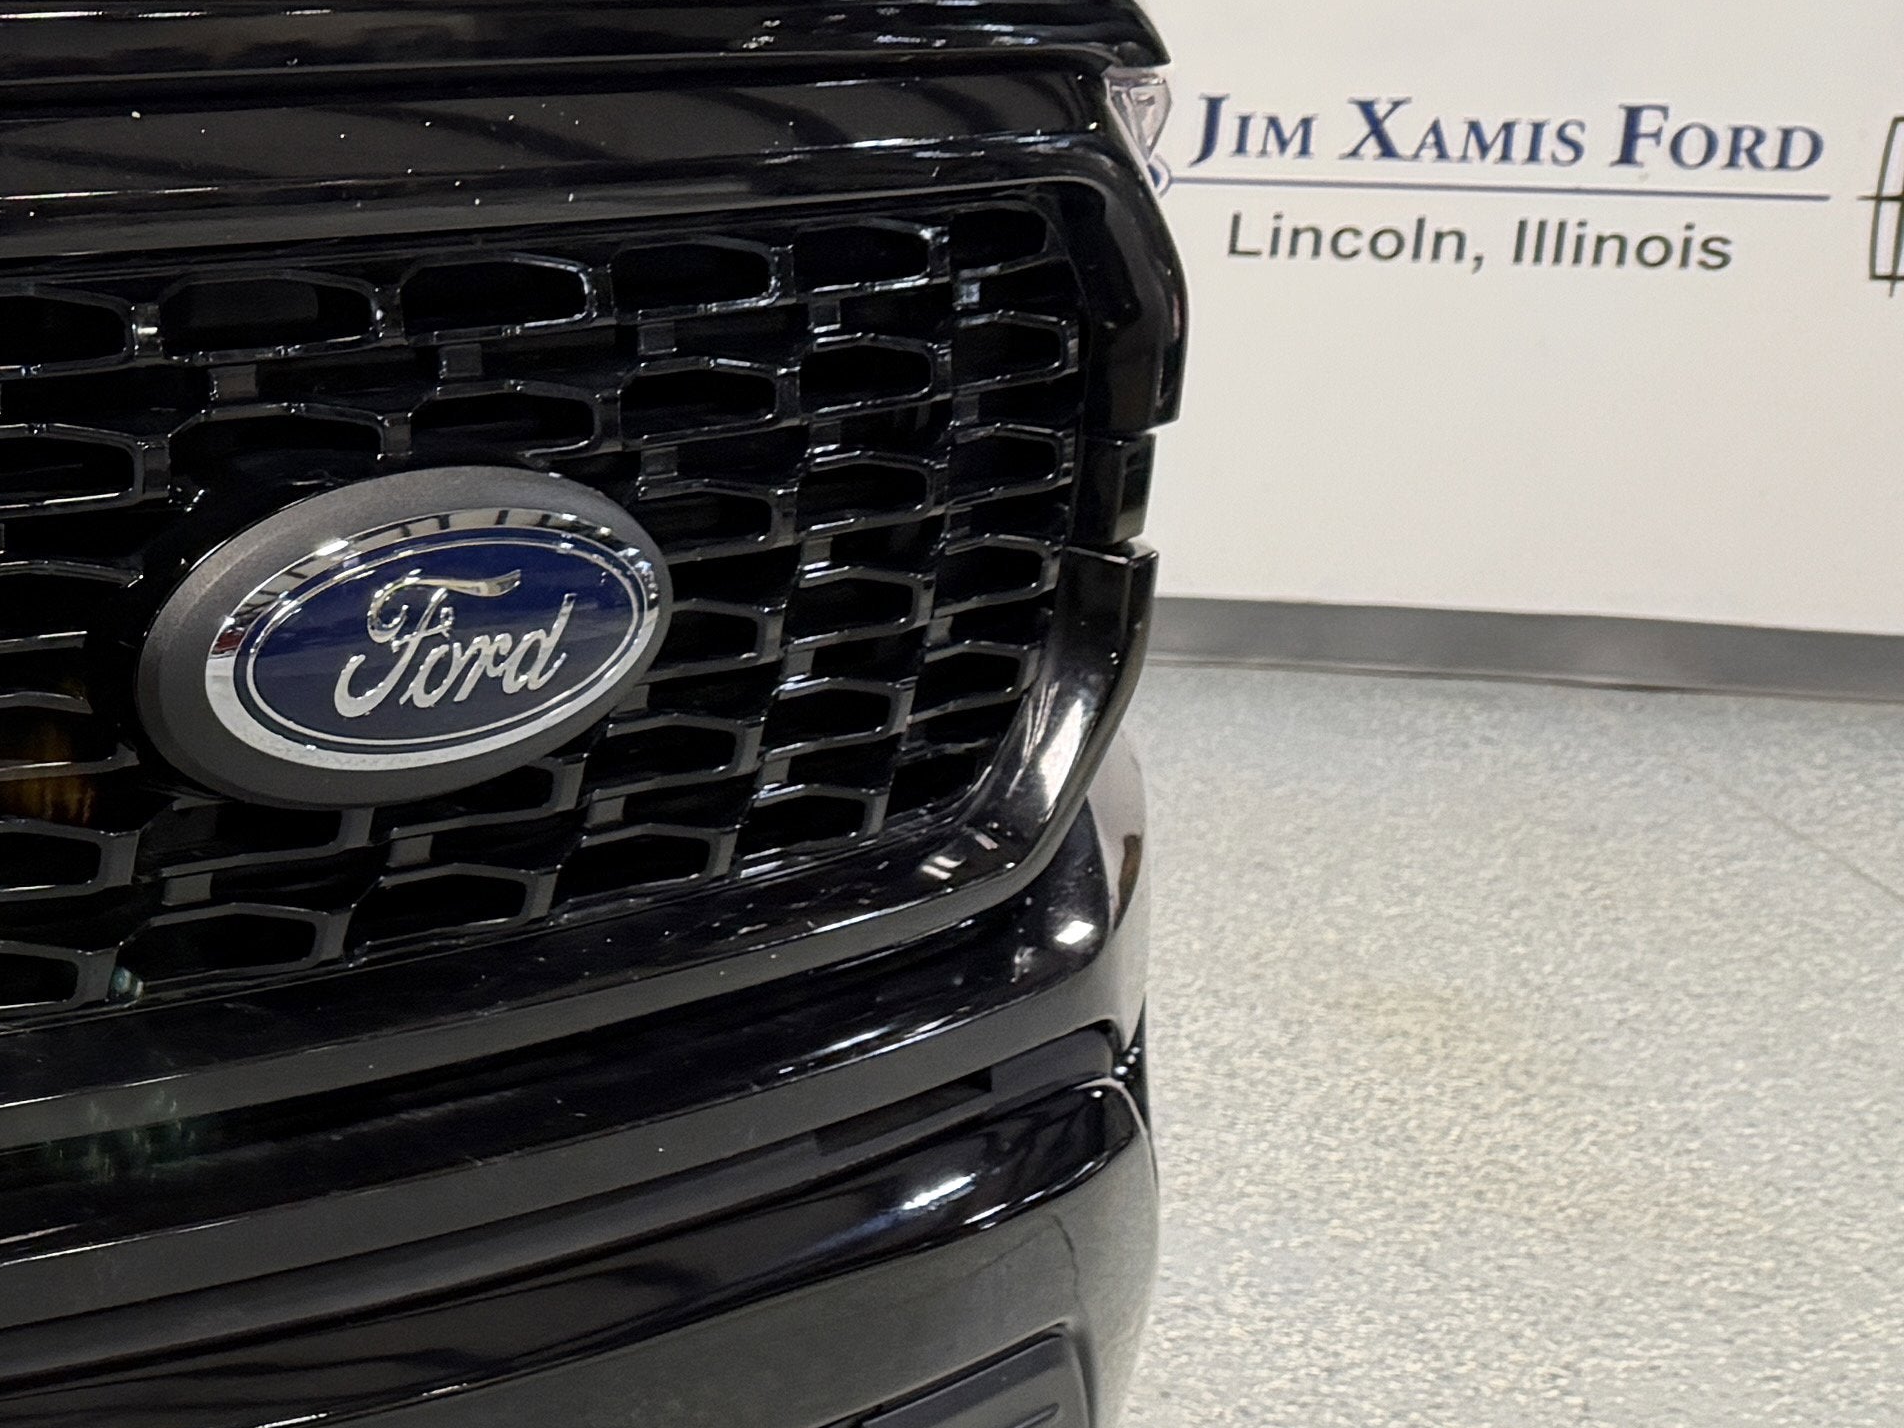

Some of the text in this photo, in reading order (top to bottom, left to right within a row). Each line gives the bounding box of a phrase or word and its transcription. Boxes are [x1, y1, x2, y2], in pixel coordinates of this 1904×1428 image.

[1188, 93, 1824, 172] JIM XAMIS FORD
[1227, 211, 1734, 274] Lincoln, Illinois
[333, 569, 577, 718] Ford
